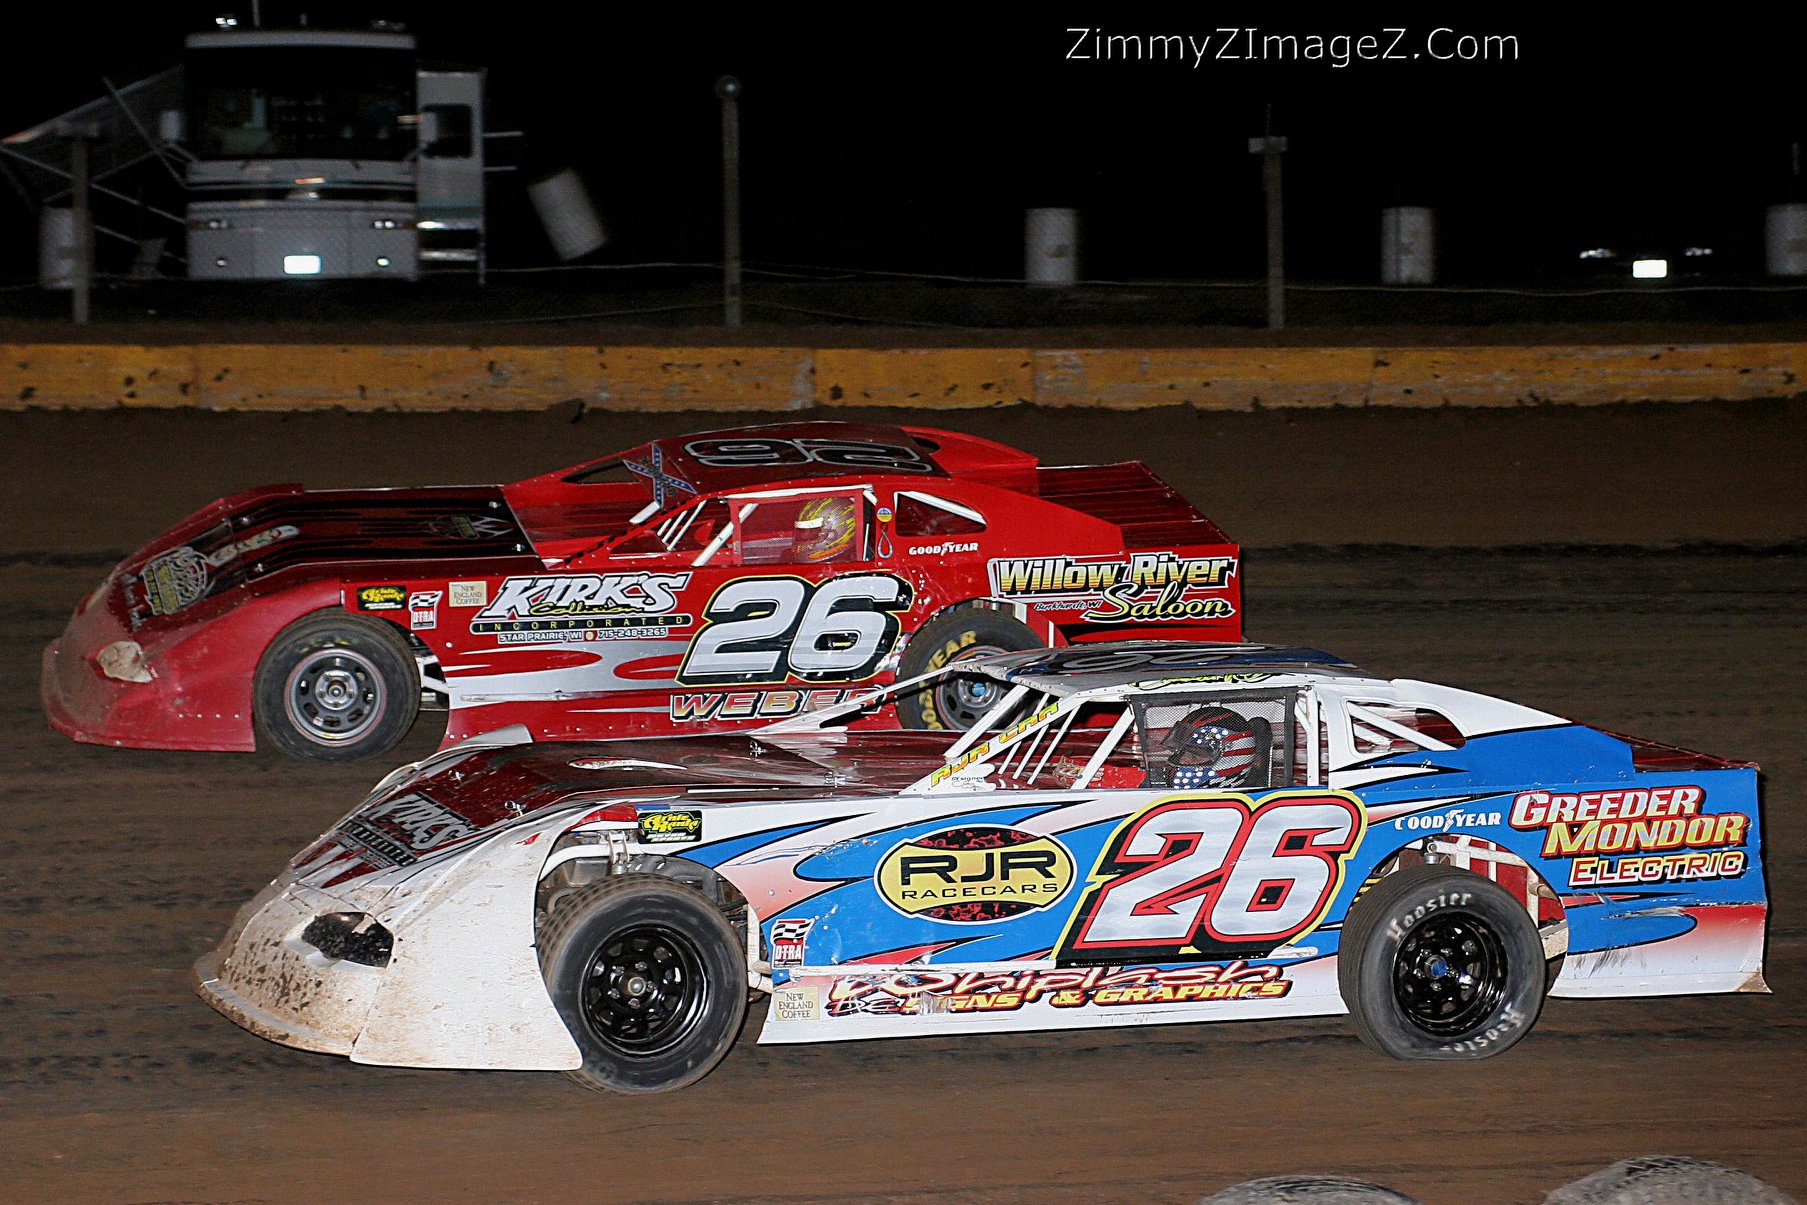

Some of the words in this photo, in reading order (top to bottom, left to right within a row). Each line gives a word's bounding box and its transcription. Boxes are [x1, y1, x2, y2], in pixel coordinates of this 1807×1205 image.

[908, 542, 979, 556] GOODYEAR
[997, 557, 1124, 595] Willow
[1130, 554, 1232, 588] River
[474, 573, 692, 618] KIRK'S
[529, 602, 645, 616] Collision
[1083, 581, 1234, 622] Saloon
[479, 616, 684, 632] INCORPORATED
[499, 633, 525, 642] STAR
[570, 631, 582, 640] WI
[598, 628, 667, 639] 715-248-3265
[676, 572, 908, 684] 26
[931, 742, 990, 787] RJR
[1509, 787, 1703, 828] GREEDER
[1541, 814, 1750, 856] MONDOR
[900, 850, 1057, 886] RJR
[1070, 795, 1364, 951] 26
[1570, 849, 1747, 886] ELECTRIC
[901, 882, 1059, 900] RACECARS
[778, 1001, 814, 1010] ENGLAND
[786, 992, 804, 1000] NEW
[1093, 978, 1291, 1005] GRAPHICS
[781, 1010, 811, 1019] COFFEE
